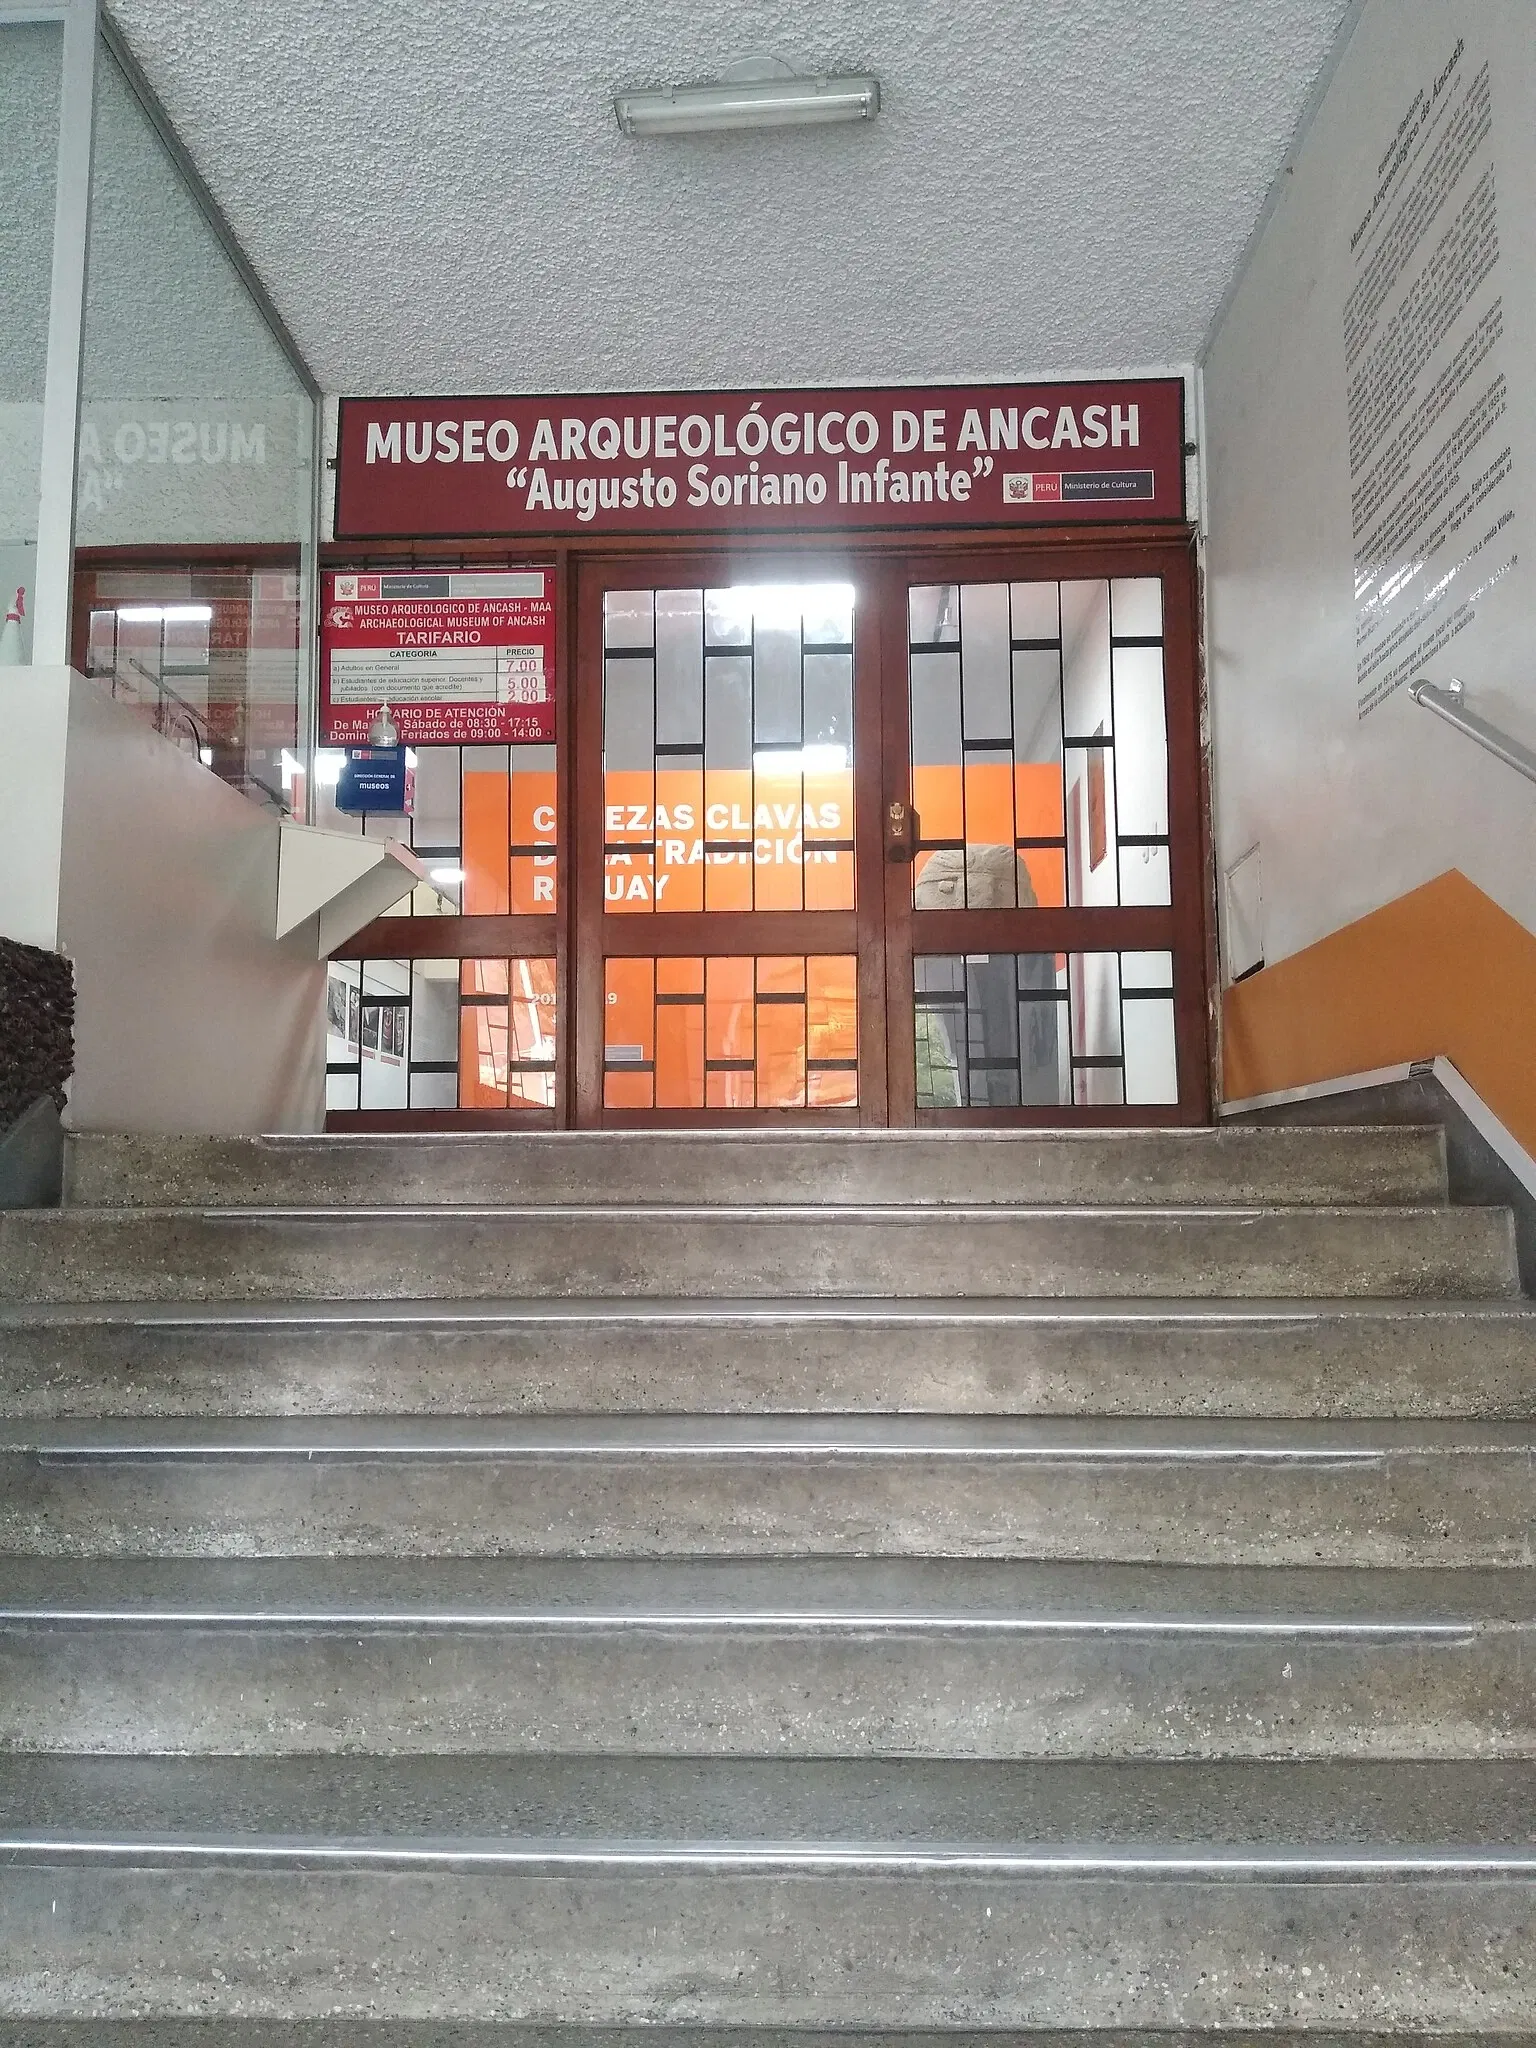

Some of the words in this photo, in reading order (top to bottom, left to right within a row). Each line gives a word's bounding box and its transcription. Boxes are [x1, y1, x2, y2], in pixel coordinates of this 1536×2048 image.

[1351, 210, 1371, 252] Museo
[1373, 123, 1418, 212] Arqueológico
[1421, 100, 1430, 123] de
[365, 420, 519, 465] MUSEO
[530, 402, 879, 461] ARQUEOLÓGICO
[892, 409, 946, 454] DE
[957, 404, 1141, 450] ANCASH
[506, 466, 677, 522] “Augusto
[686, 461, 823, 507] Soriano
[838, 455, 995, 504] Infante”
[1035, 481, 1057, 492] PERÚ
[355, 606, 389, 615] MUSEO
[391, 604, 464, 614] ARQUEOLOGICO
[468, 604, 480, 613] DE
[483, 603, 520, 612] ANCASH
[531, 602, 551, 611] MAA
[360, 618, 444, 629] ARCHAEOLOGICAL
[447, 617, 489, 627] MUSEUM
[492, 617, 504, 626] OF
[507, 616, 545, 626] ANCASH
[397, 631, 481, 644] TARIFARIO
[390, 650, 437, 658] CATEGORIA
[507, 660, 536, 672] 7.00
[422, 684, 434, 692] que
[508, 677, 537, 689] 5.00
[508, 690, 538, 702] 2.00
[366, 708, 422, 718] HOARIO
[426, 709, 441, 718] DE
[445, 705, 505, 718] ATENCIÓN
[334, 721, 348, 729] De
[404, 718, 447, 728] Sábado
[450, 719, 462, 727] de
[466, 719, 498, 727] 08:30
[509, 718, 538, 727] 17:15
[401, 730, 449, 739] Feriados
[454, 729, 466, 738] de
[470, 729, 501, 738] 09:00
[512, 728, 541, 737] 14:00
[533, 804, 695, 831] CEZAS
[707, 803, 841, 830] CLAVAS
[533, 875, 670, 900] RUAY
